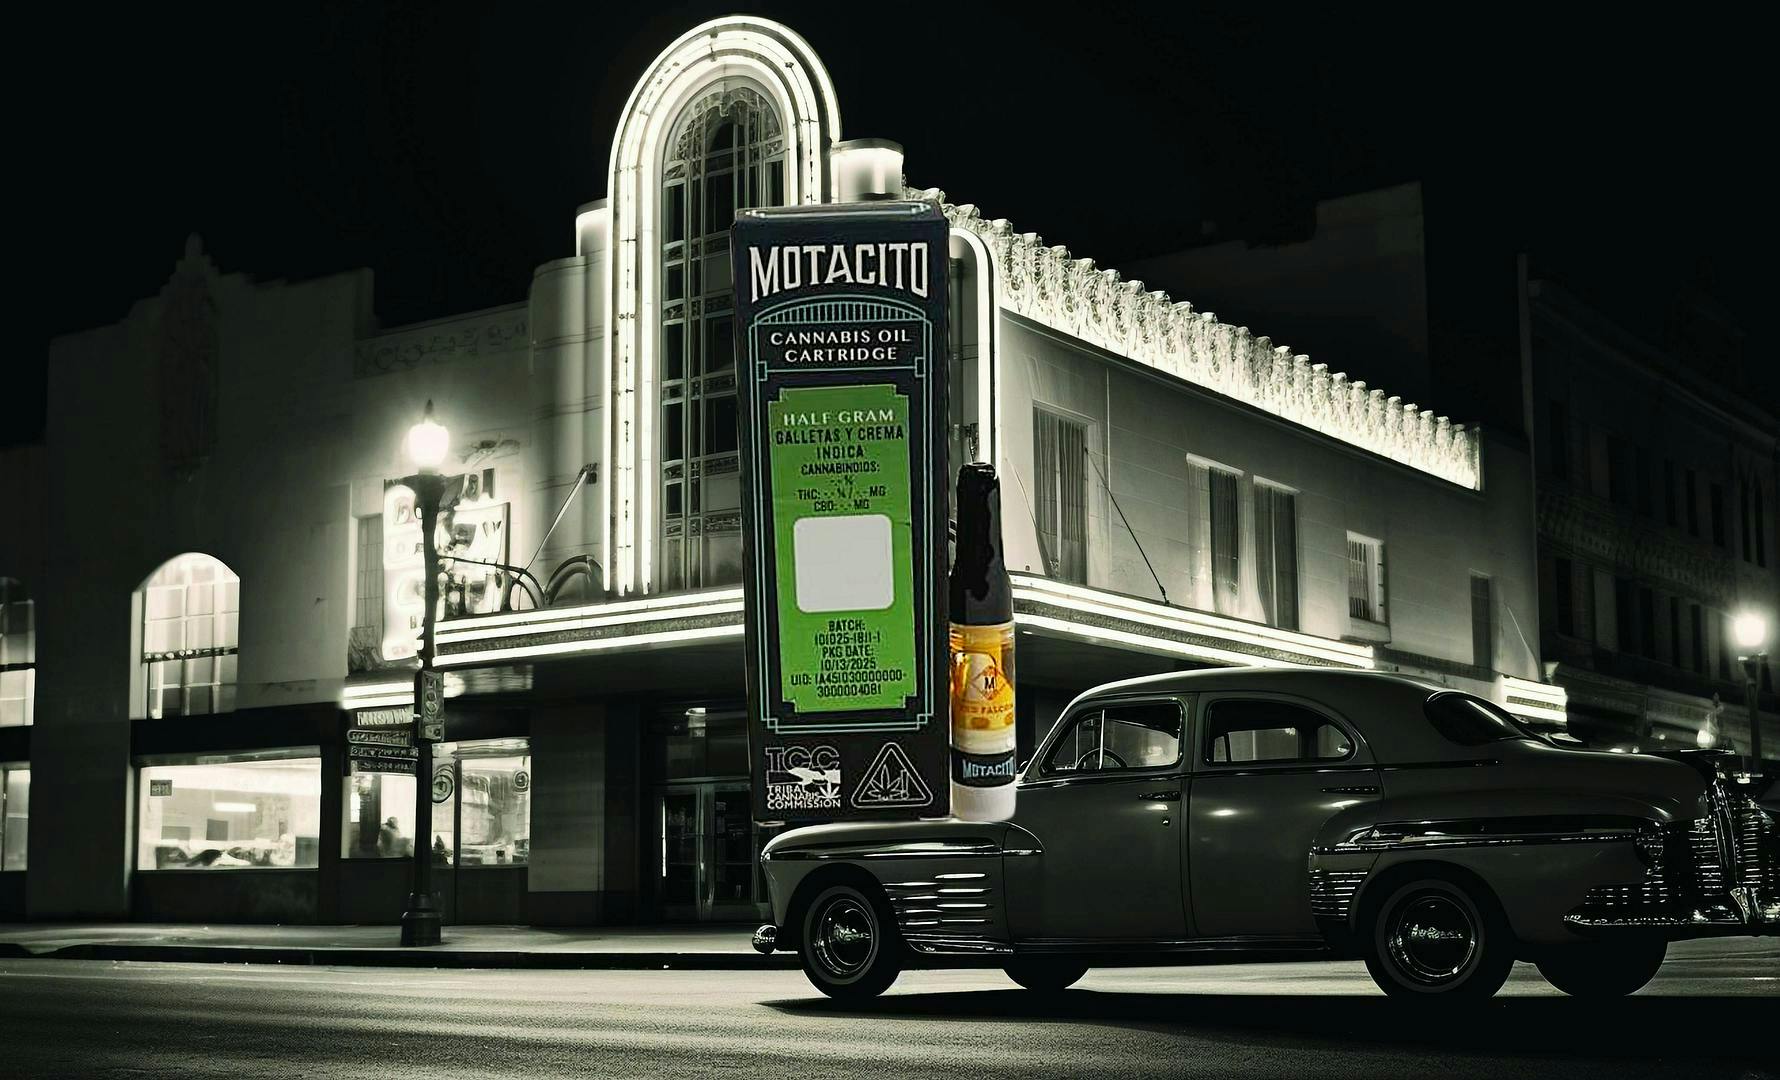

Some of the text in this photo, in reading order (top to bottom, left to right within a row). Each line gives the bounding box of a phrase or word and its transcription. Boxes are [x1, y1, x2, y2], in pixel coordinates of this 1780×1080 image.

[749, 242, 928, 303] MOTACITO
[770, 329, 912, 346] CANNABIS OIL
[784, 347, 897, 362] CARTRIDGE
[783, 409, 894, 426] HALF GRAM
[776, 425, 904, 445] GALLETAS Y CREMA
[816, 445, 864, 460] INDICA
[828, 620, 866, 632] BATCH:
[815, 631, 881, 646] 101025-1811-1
[822, 645, 874, 658] PKG DATE:
[821, 657, 877, 671] 10/13/2025
[790, 674, 812, 686] UID:
[984, 676, 995, 690] M
[766, 784, 808, 794] TRIBAL
[767, 792, 820, 802] CANNABIS
[767, 799, 841, 810] COMMISSION
